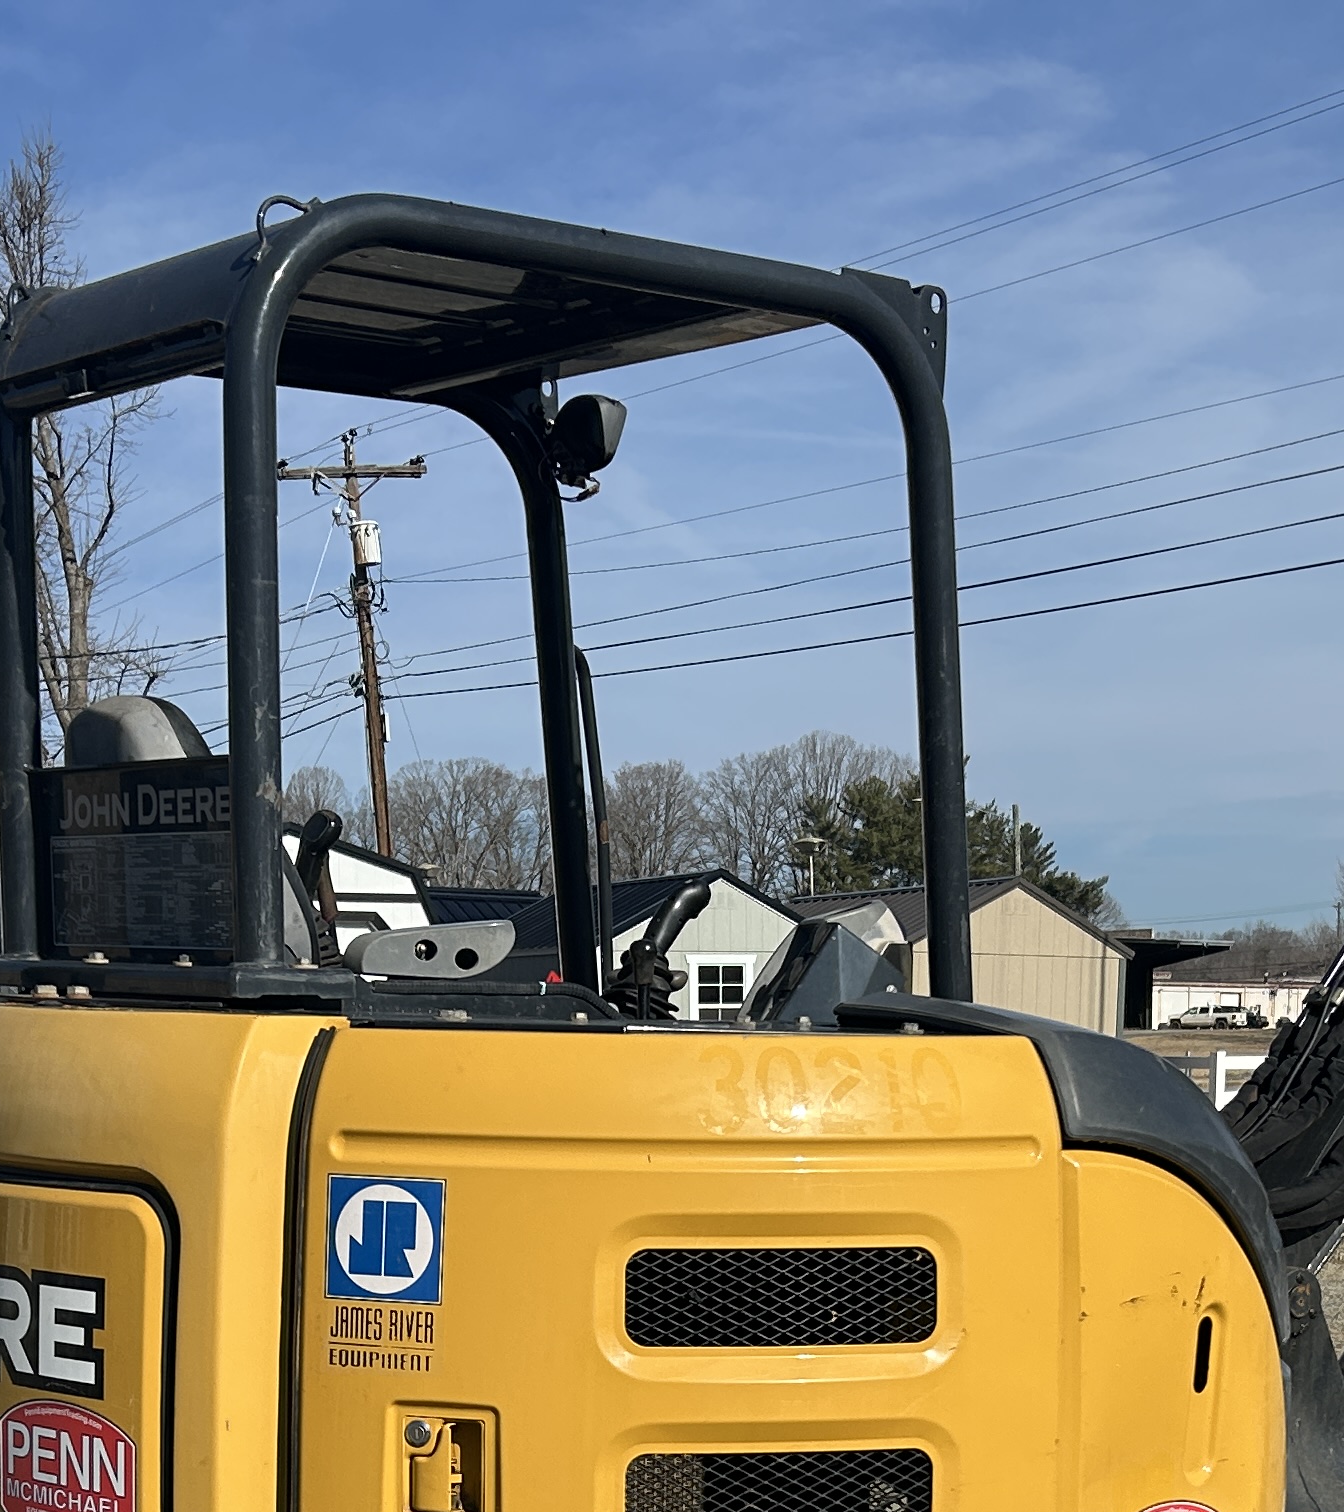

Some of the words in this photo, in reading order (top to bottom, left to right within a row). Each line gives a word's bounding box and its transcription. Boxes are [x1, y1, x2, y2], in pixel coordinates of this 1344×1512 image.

[59, 789, 131, 830] JOHN
[136, 784, 231, 826] DEERE
[330, 1305, 383, 1341] JAMES
[388, 1309, 434, 1344] RIVER
[7, 1420, 126, 1498] PENN
